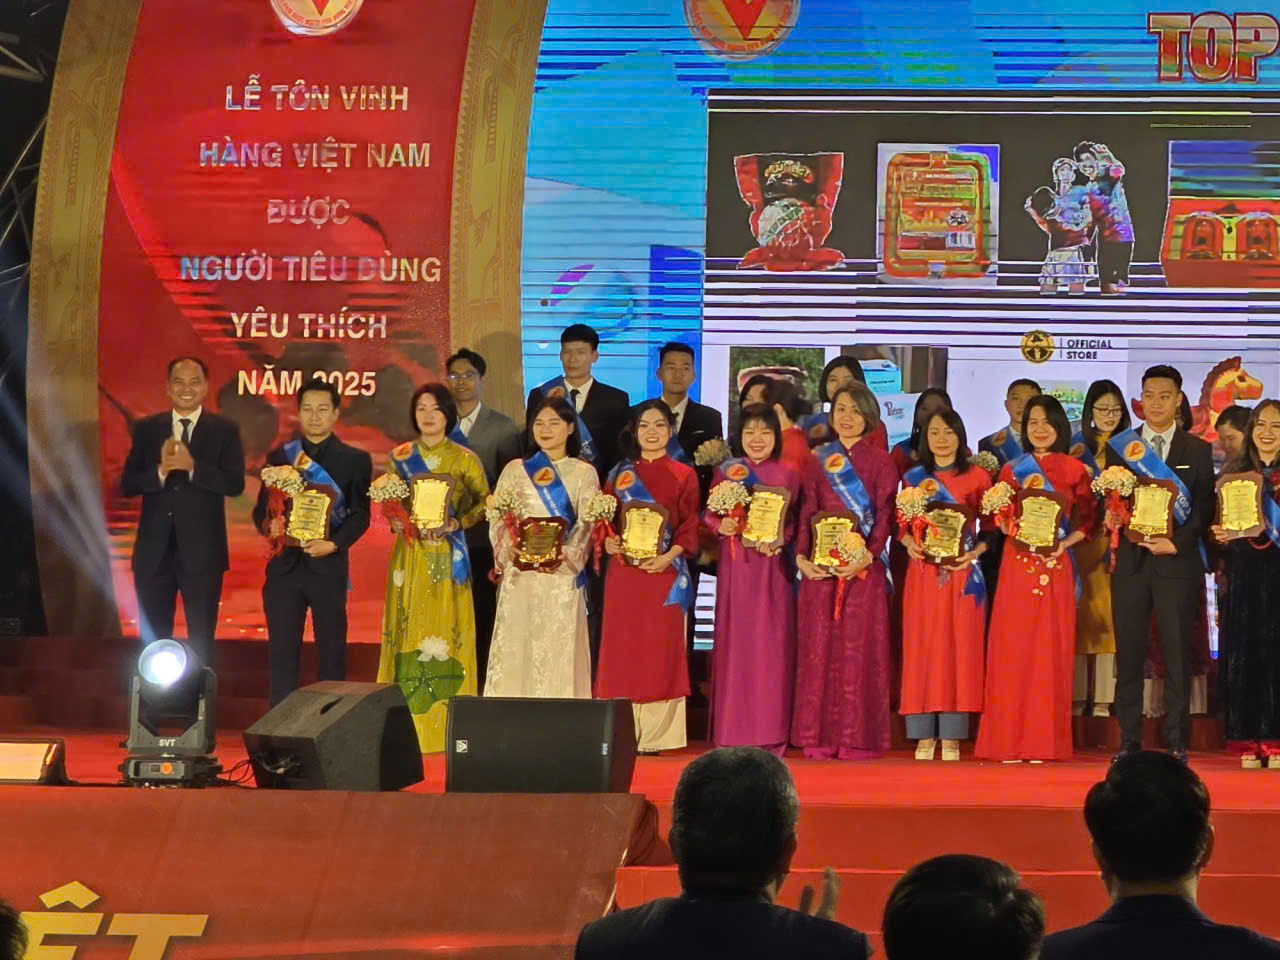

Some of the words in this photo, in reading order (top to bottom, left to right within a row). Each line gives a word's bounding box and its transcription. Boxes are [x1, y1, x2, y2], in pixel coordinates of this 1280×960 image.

[225, 74, 260, 111] LỄ
[270, 79, 330, 111] TÔN
[339, 85, 409, 111] VINH
[199, 136, 281, 167] HÀNG
[293, 136, 357, 173] VIỆT
[366, 142, 430, 167] NAM
[267, 197, 350, 230] ĐƯỢC
[179, 249, 272, 282] NGƯỜI
[283, 250, 348, 282] TIÊU
[358, 252, 441, 282] DÙNG
[230, 308, 289, 339] YÊU
[298, 307, 387, 339] THÍCH
[1066, 339, 1113, 349] OFFICIAL
[1066, 351, 1098, 360] STORE
[237, 363, 302, 396] NĂM
[158, 739, 176, 747] SVT
